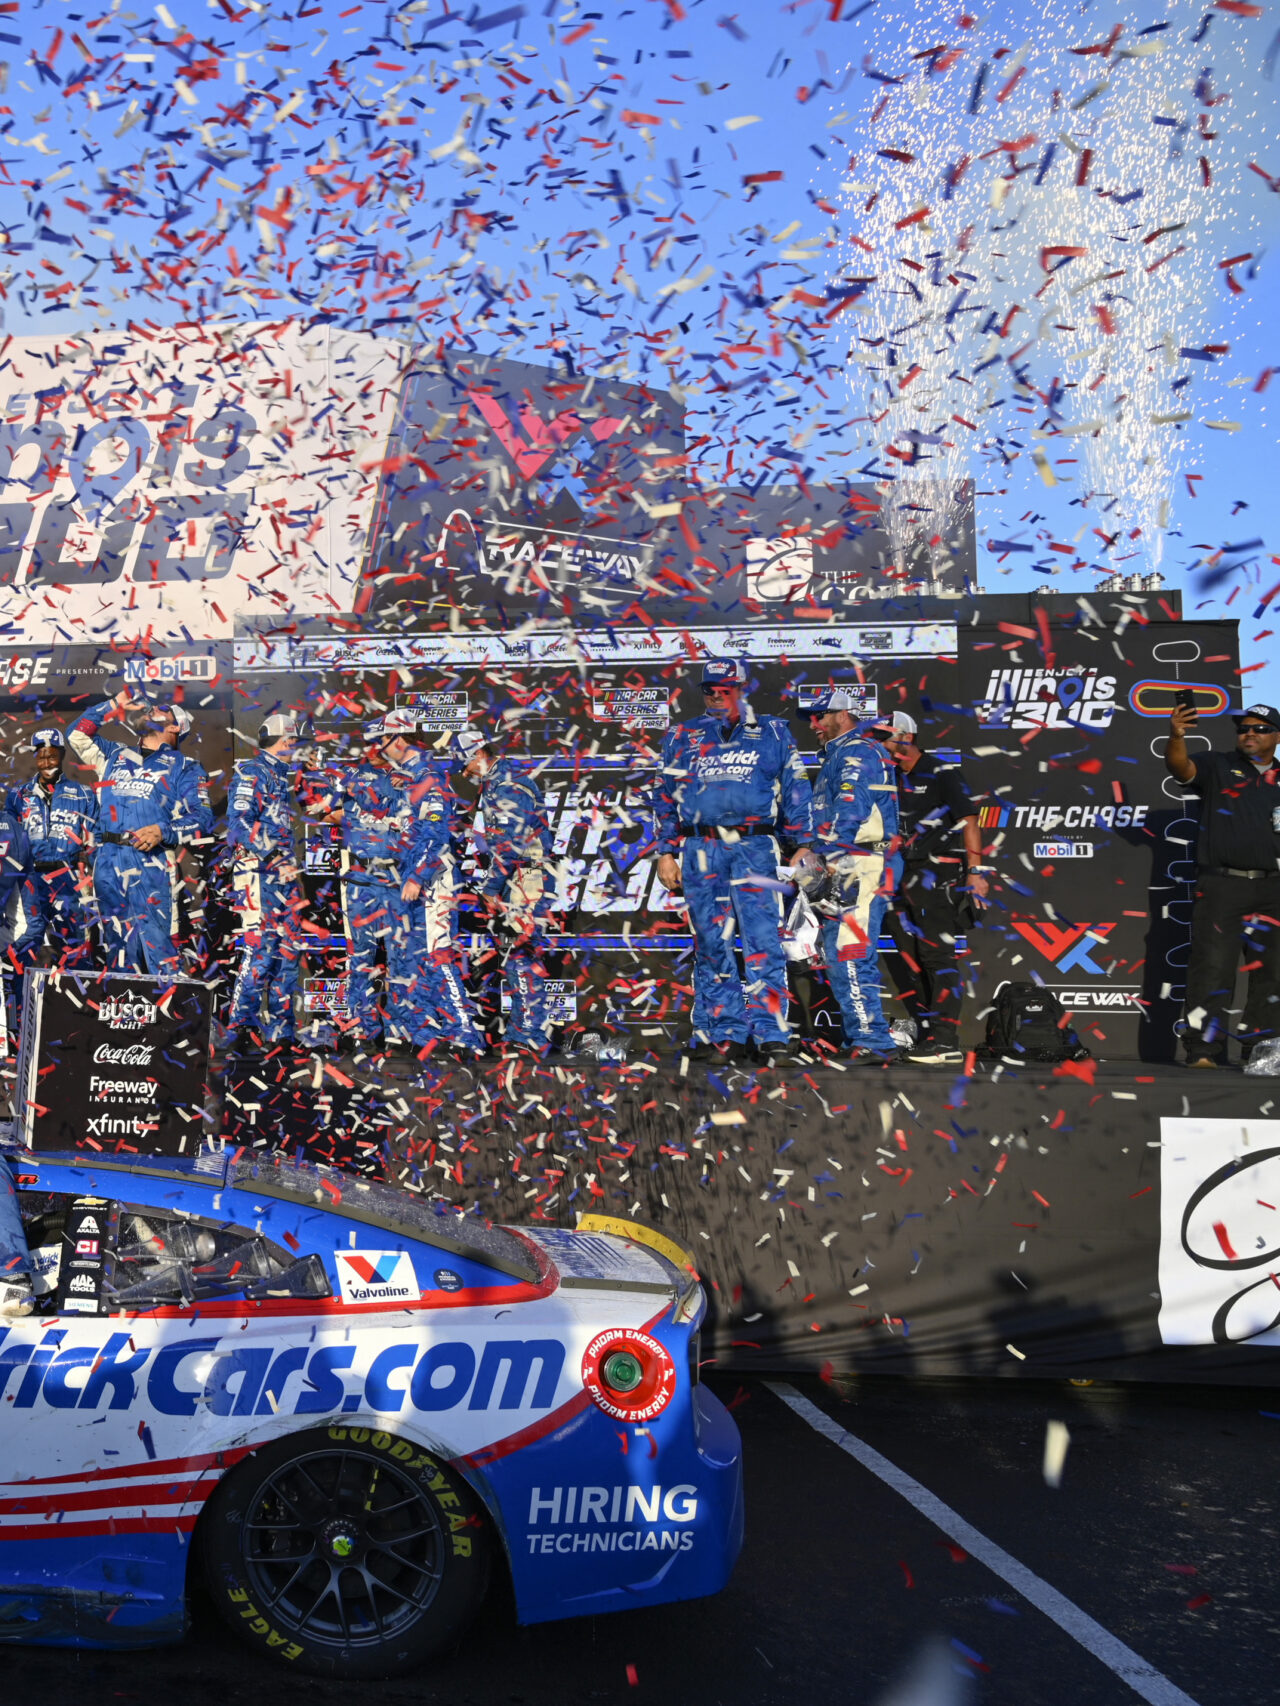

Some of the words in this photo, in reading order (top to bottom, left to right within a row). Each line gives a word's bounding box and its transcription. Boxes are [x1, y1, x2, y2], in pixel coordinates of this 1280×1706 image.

[821, 570, 858, 585] THE
[56, 667, 106, 675] PRESENTED
[127, 659, 186, 681] Mobil
[420, 694, 457, 705] NASCAR
[618, 690, 658, 701] NASCAR
[428, 708, 458, 718] SERIES
[624, 704, 658, 715] SERIES
[1011, 701, 1115, 729] 300
[428, 723, 441, 731] THE
[442, 723, 463, 731] CHASE
[1015, 806, 1063, 828] THE
[1064, 806, 1149, 828] CHASE
[1035, 844, 1073, 856] Mobil
[1053, 992, 1140, 1006] CEWAY
[98, 1002, 157, 1024] BUSCH
[93, 1043, 157, 1066] Coca-Cola
[90, 1076, 158, 1097] Freeway
[86, 1113, 154, 1137] xfinity
[76, 1241, 98, 1254] CI
[70, 1273, 96, 1288] MAC
[349, 1286, 409, 1299] Valvoline
[588, 1329, 623, 1358] PHORM
[625, 1329, 668, 1360] ENERGY
[588, 1384, 628, 1420] PHORM
[629, 1386, 670, 1420] ENERGY
[528, 1484, 698, 1525] HIRING
[526, 1530, 695, 1554] TECHNICIANS
[226, 1586, 305, 1661] EAGLE
